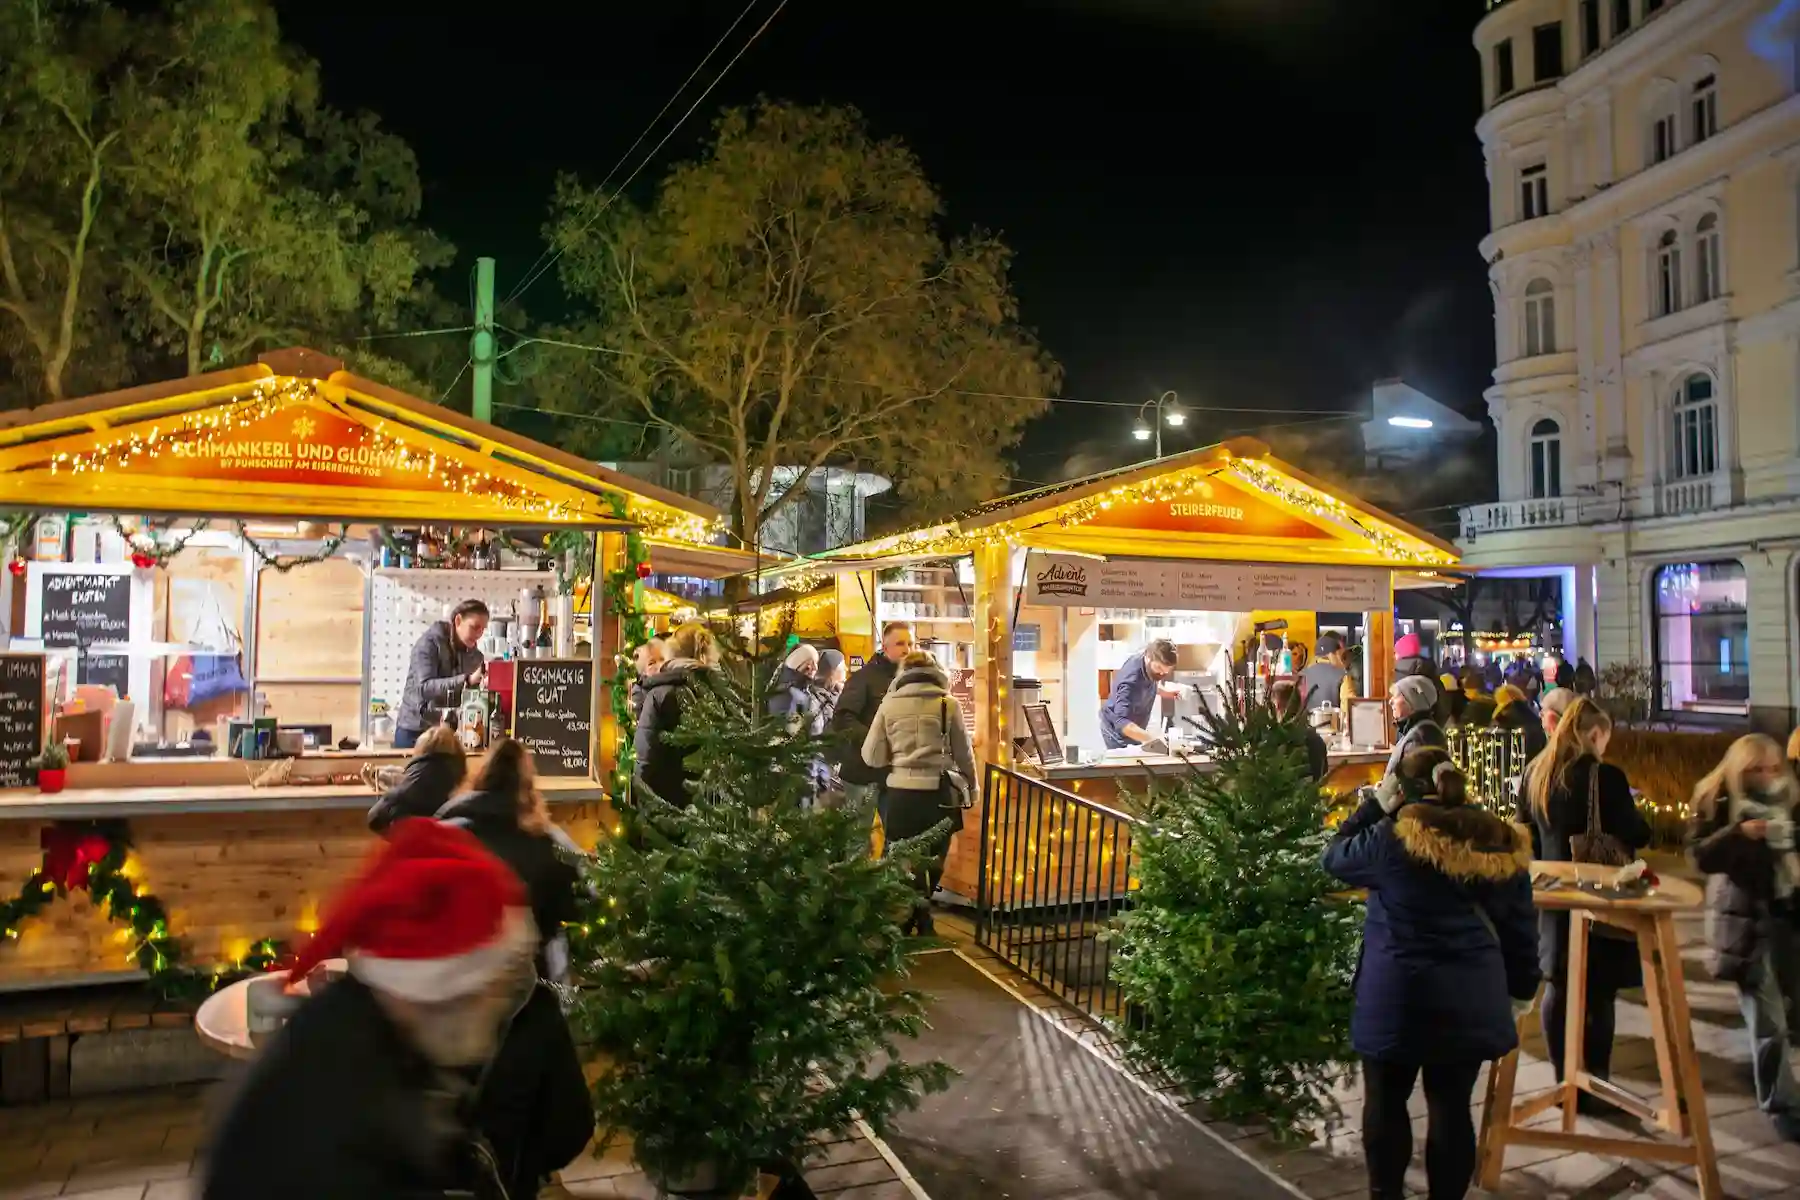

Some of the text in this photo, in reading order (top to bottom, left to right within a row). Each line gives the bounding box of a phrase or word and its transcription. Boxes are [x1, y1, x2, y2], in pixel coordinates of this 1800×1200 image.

[174, 440, 293, 458] SCHMANKERL
[296, 442, 334, 461] UND
[220, 458, 233, 468] BY
[235, 458, 294, 470] PUNSCHZEIT
[295, 460, 310, 470] AM
[1170, 503, 1244, 521] STEIRERFEUER
[1036, 562, 1087, 583] Advent
[523, 667, 584, 685] GSCHMACKIG
[536, 685, 568, 704] GUAT
